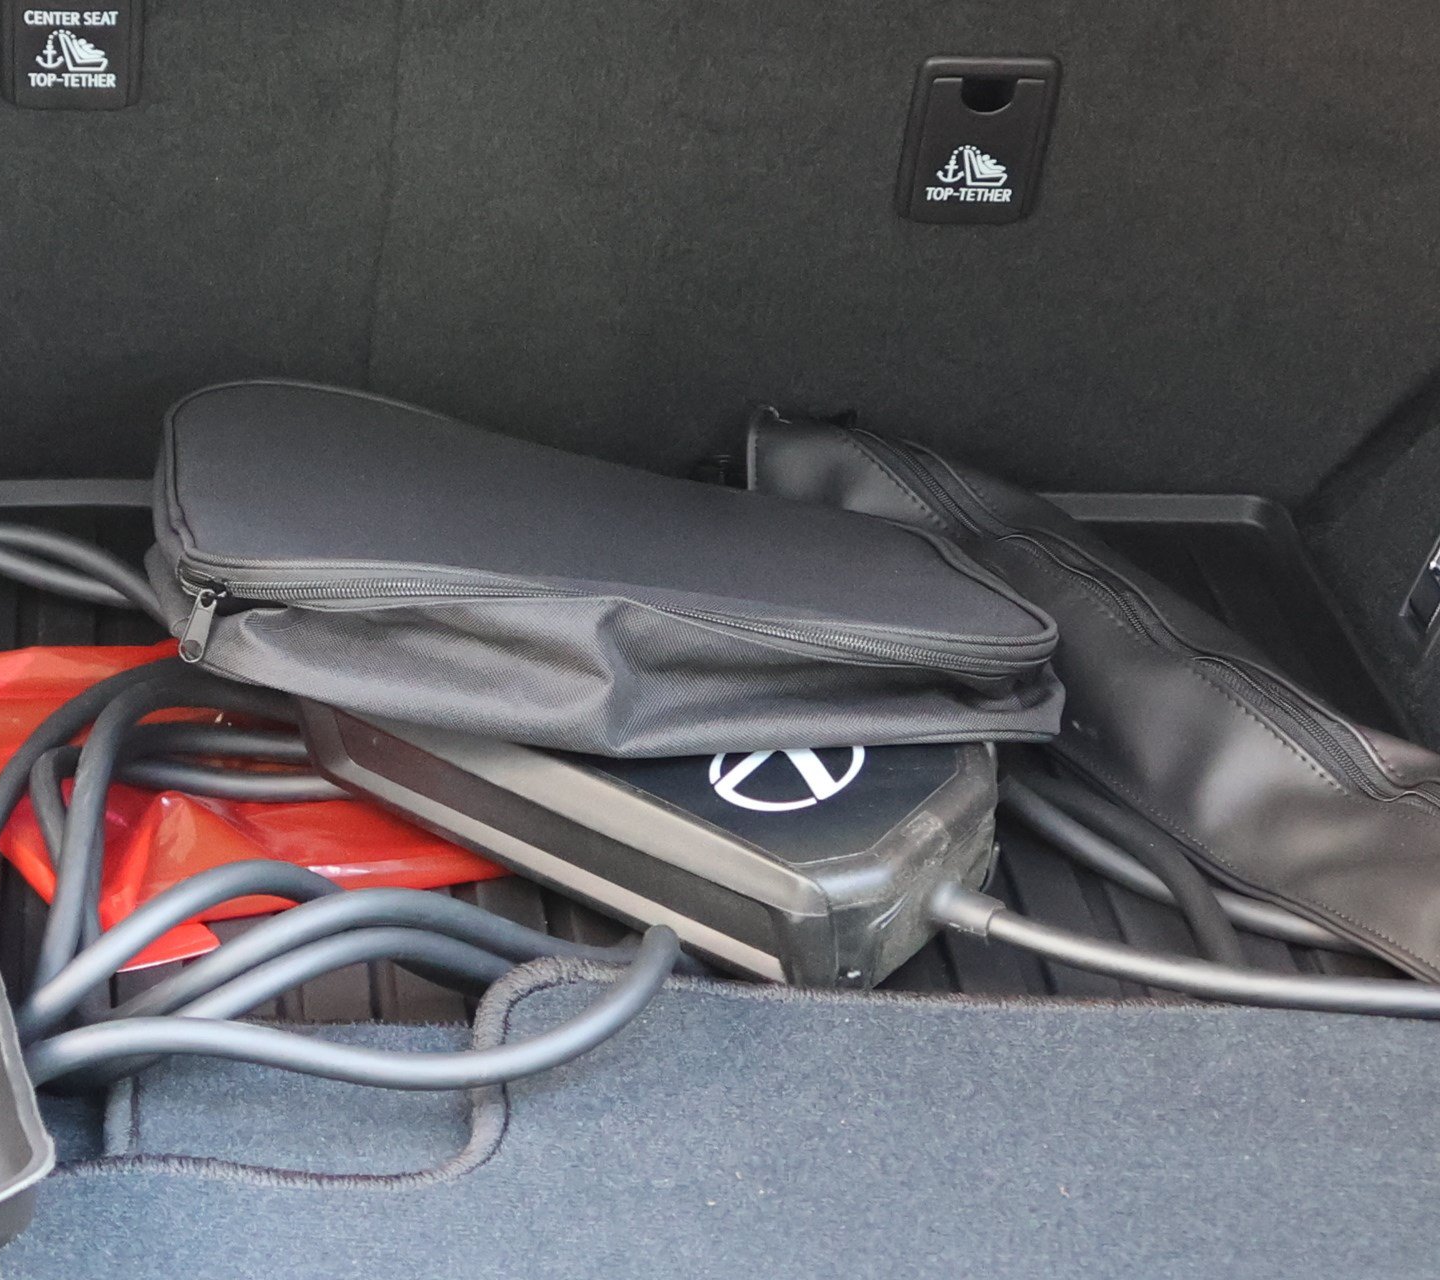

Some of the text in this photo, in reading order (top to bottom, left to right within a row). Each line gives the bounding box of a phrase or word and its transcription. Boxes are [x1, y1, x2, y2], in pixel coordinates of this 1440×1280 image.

[23, 10, 119, 25] CENTER SEAT
[28, 72, 116, 88] TOP-TETHER
[925, 186, 1012, 203] TOP-TETHER
